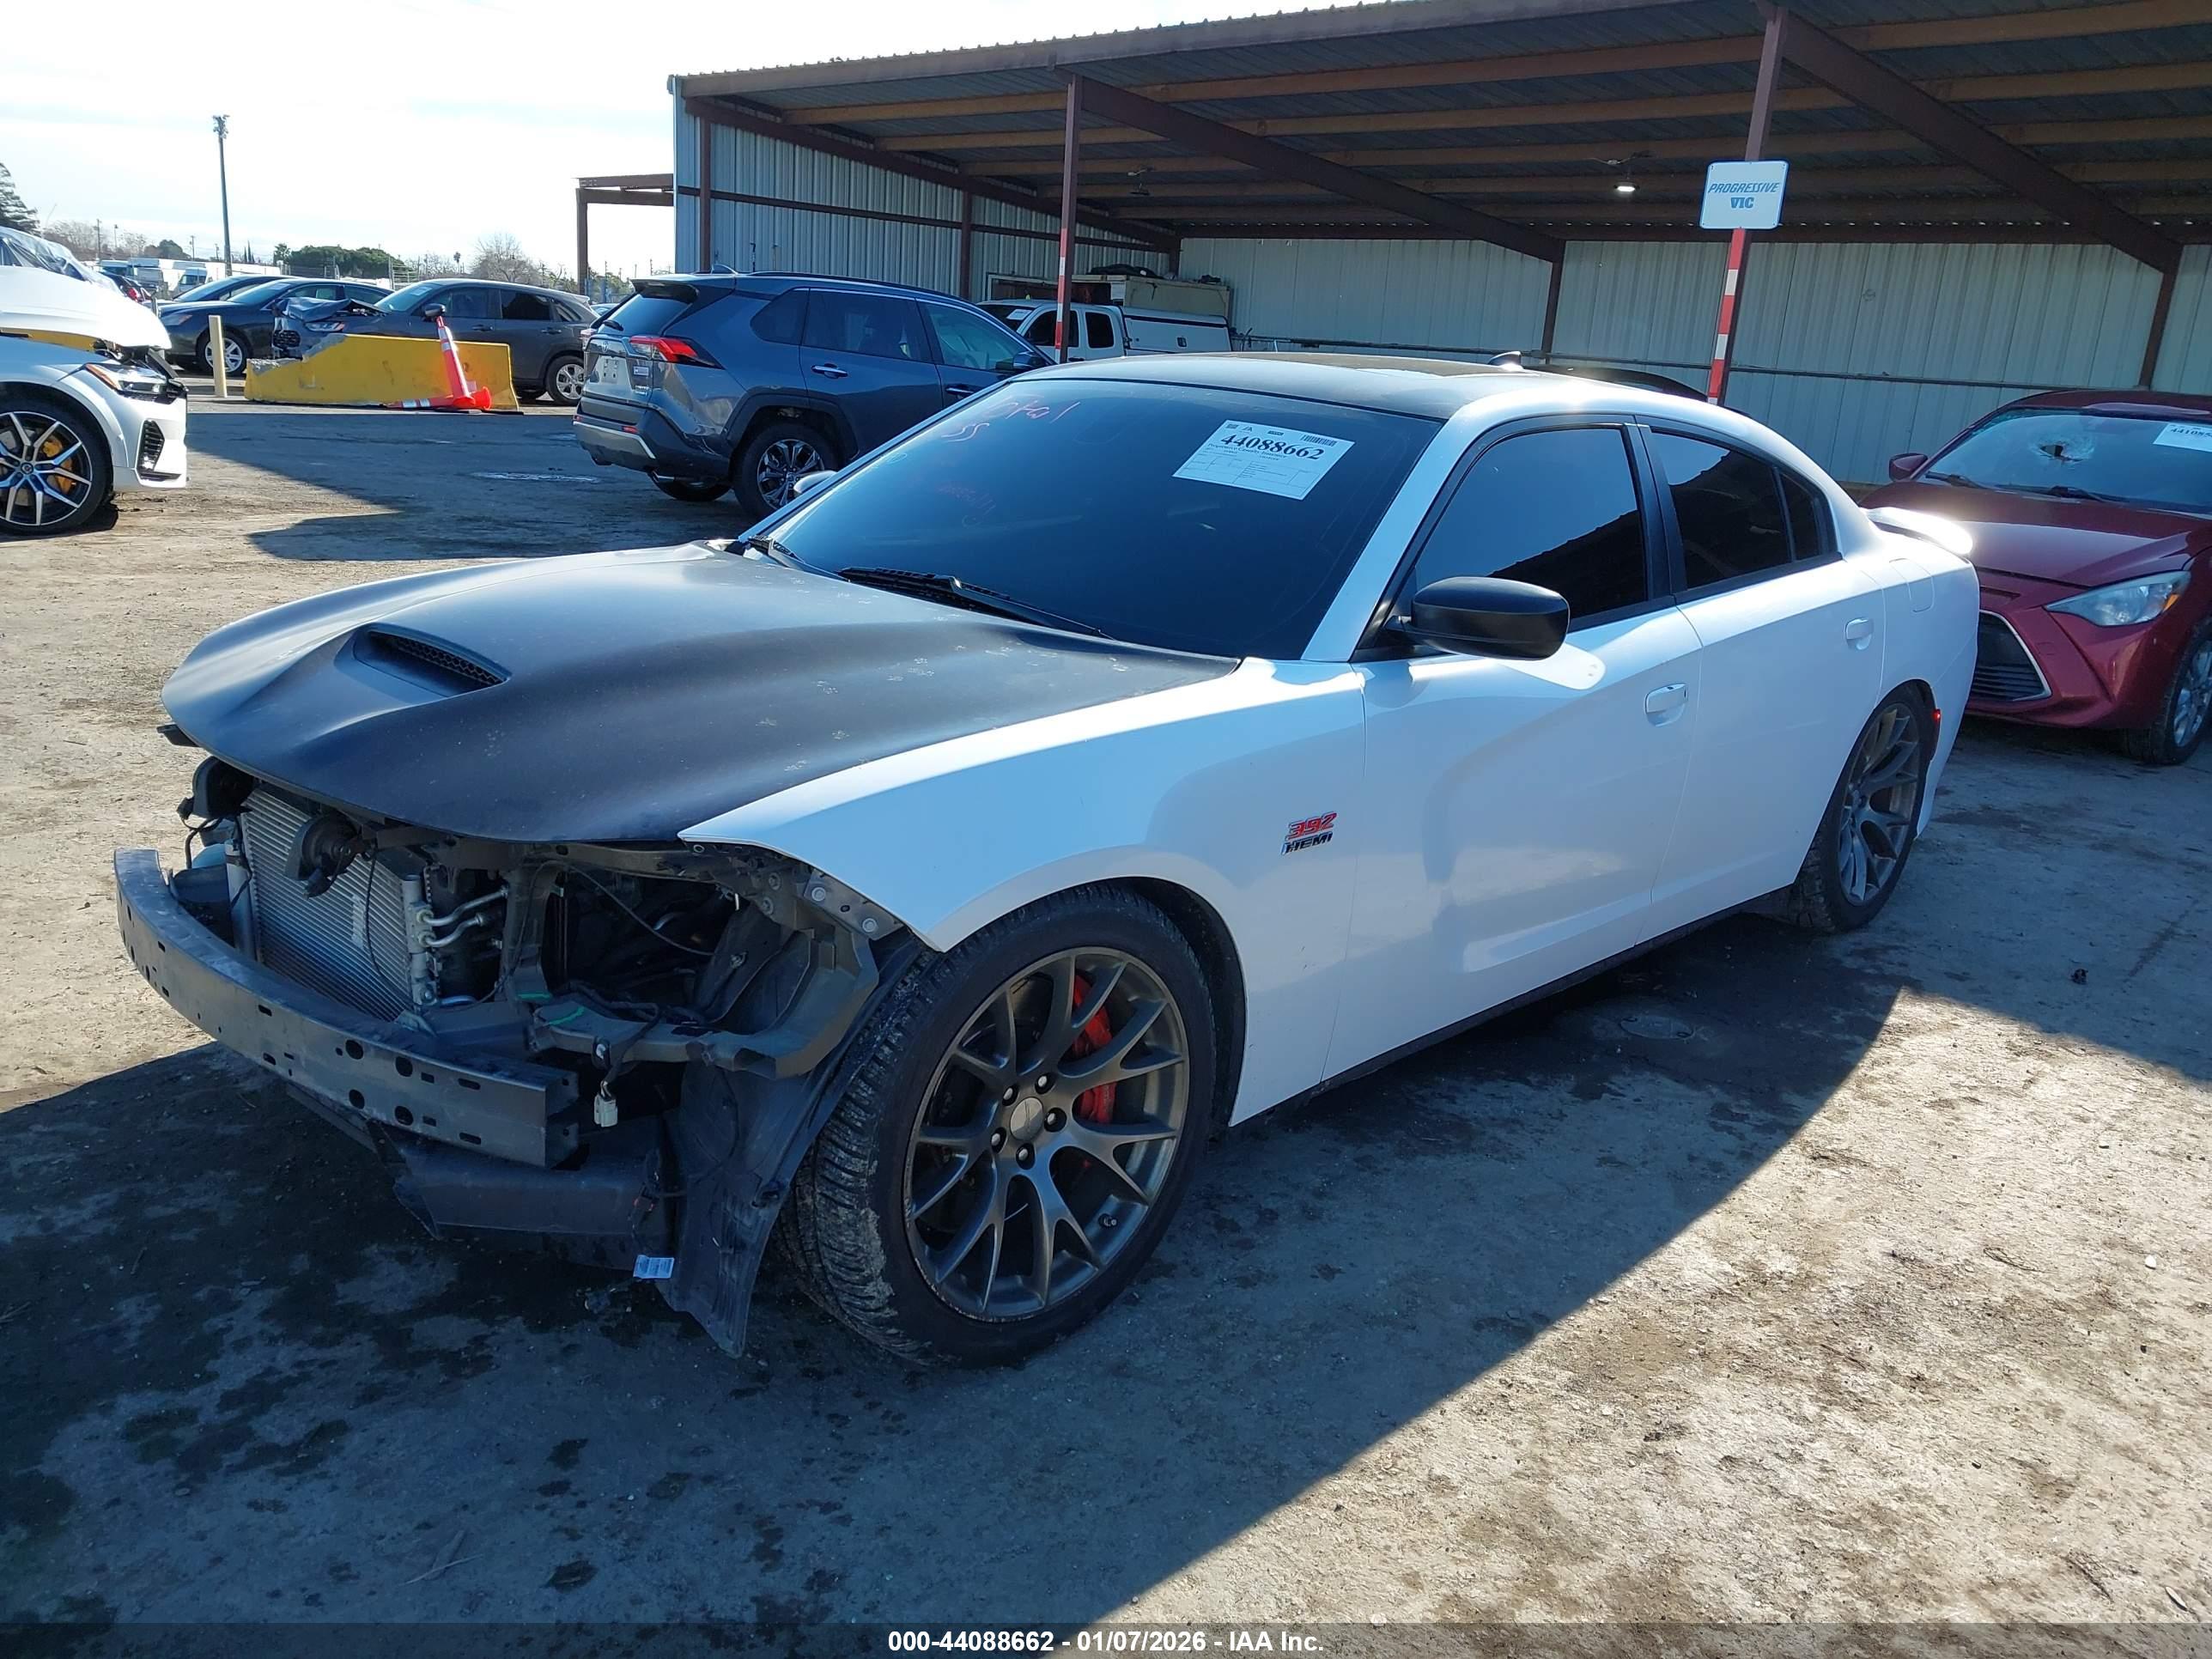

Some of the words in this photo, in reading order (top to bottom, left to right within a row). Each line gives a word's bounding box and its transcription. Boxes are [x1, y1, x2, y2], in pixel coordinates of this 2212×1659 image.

[1708, 182, 1780, 193] PROGRESSIVE
[1730, 197, 1754, 209] VIC
[1221, 434, 1325, 460] 44088662
[1285, 811, 1338, 841] 392
[1280, 831, 1334, 856] HEMI
